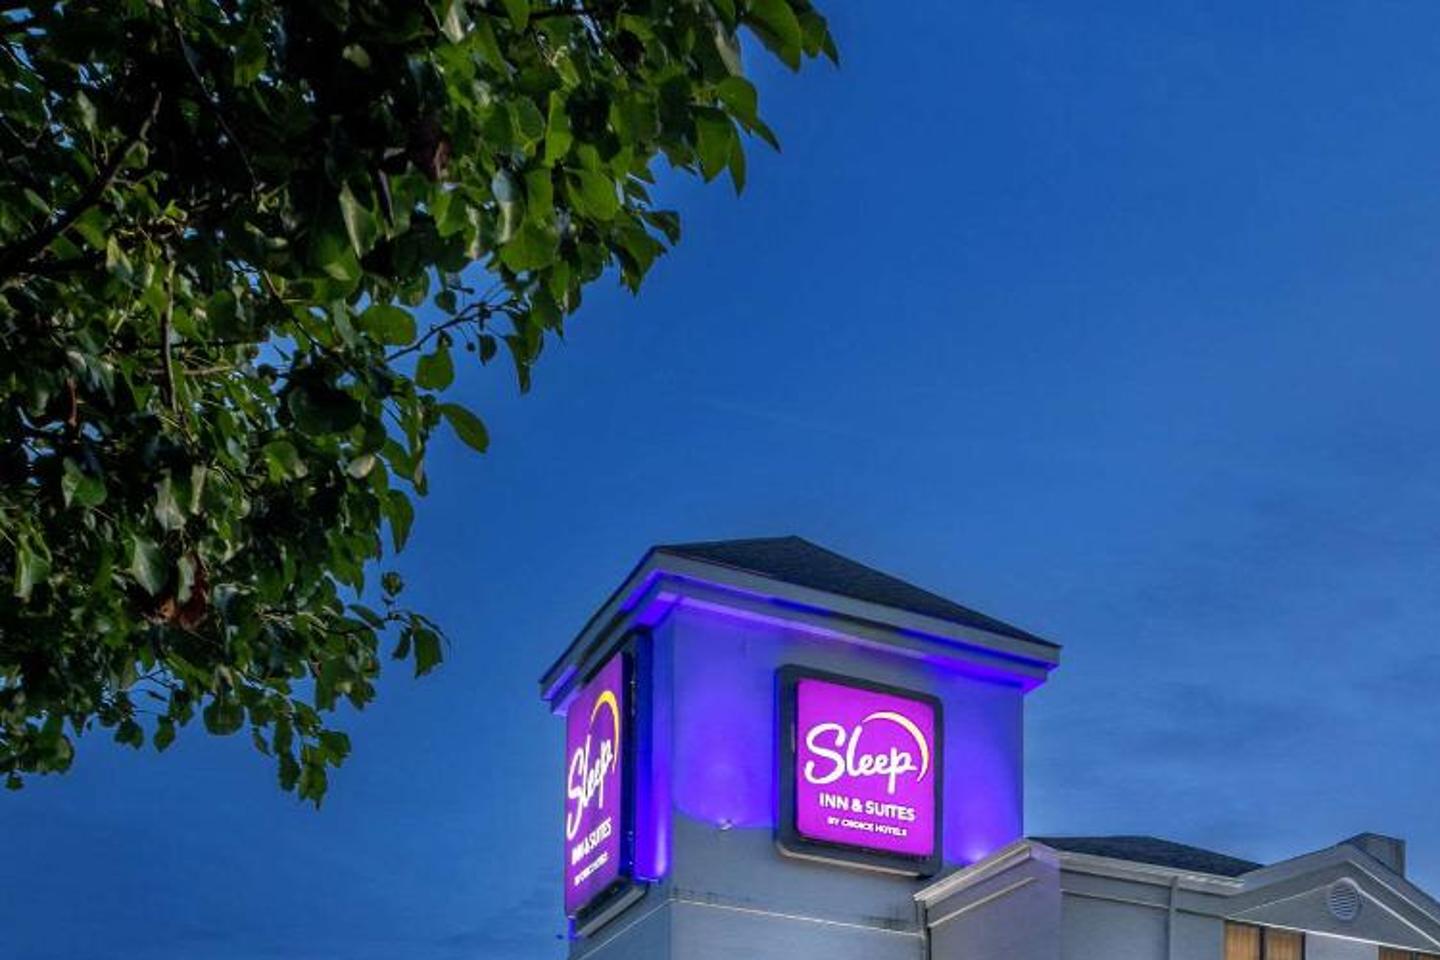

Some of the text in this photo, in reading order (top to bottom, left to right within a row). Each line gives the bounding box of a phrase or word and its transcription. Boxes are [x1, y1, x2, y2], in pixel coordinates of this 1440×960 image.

[804, 723, 919, 794] Sleep
[567, 734, 614, 841] Sleep
[819, 793, 916, 821] INN & SUITES
[827, 816, 838, 825] BY
[875, 823, 907, 836] HOTELS
